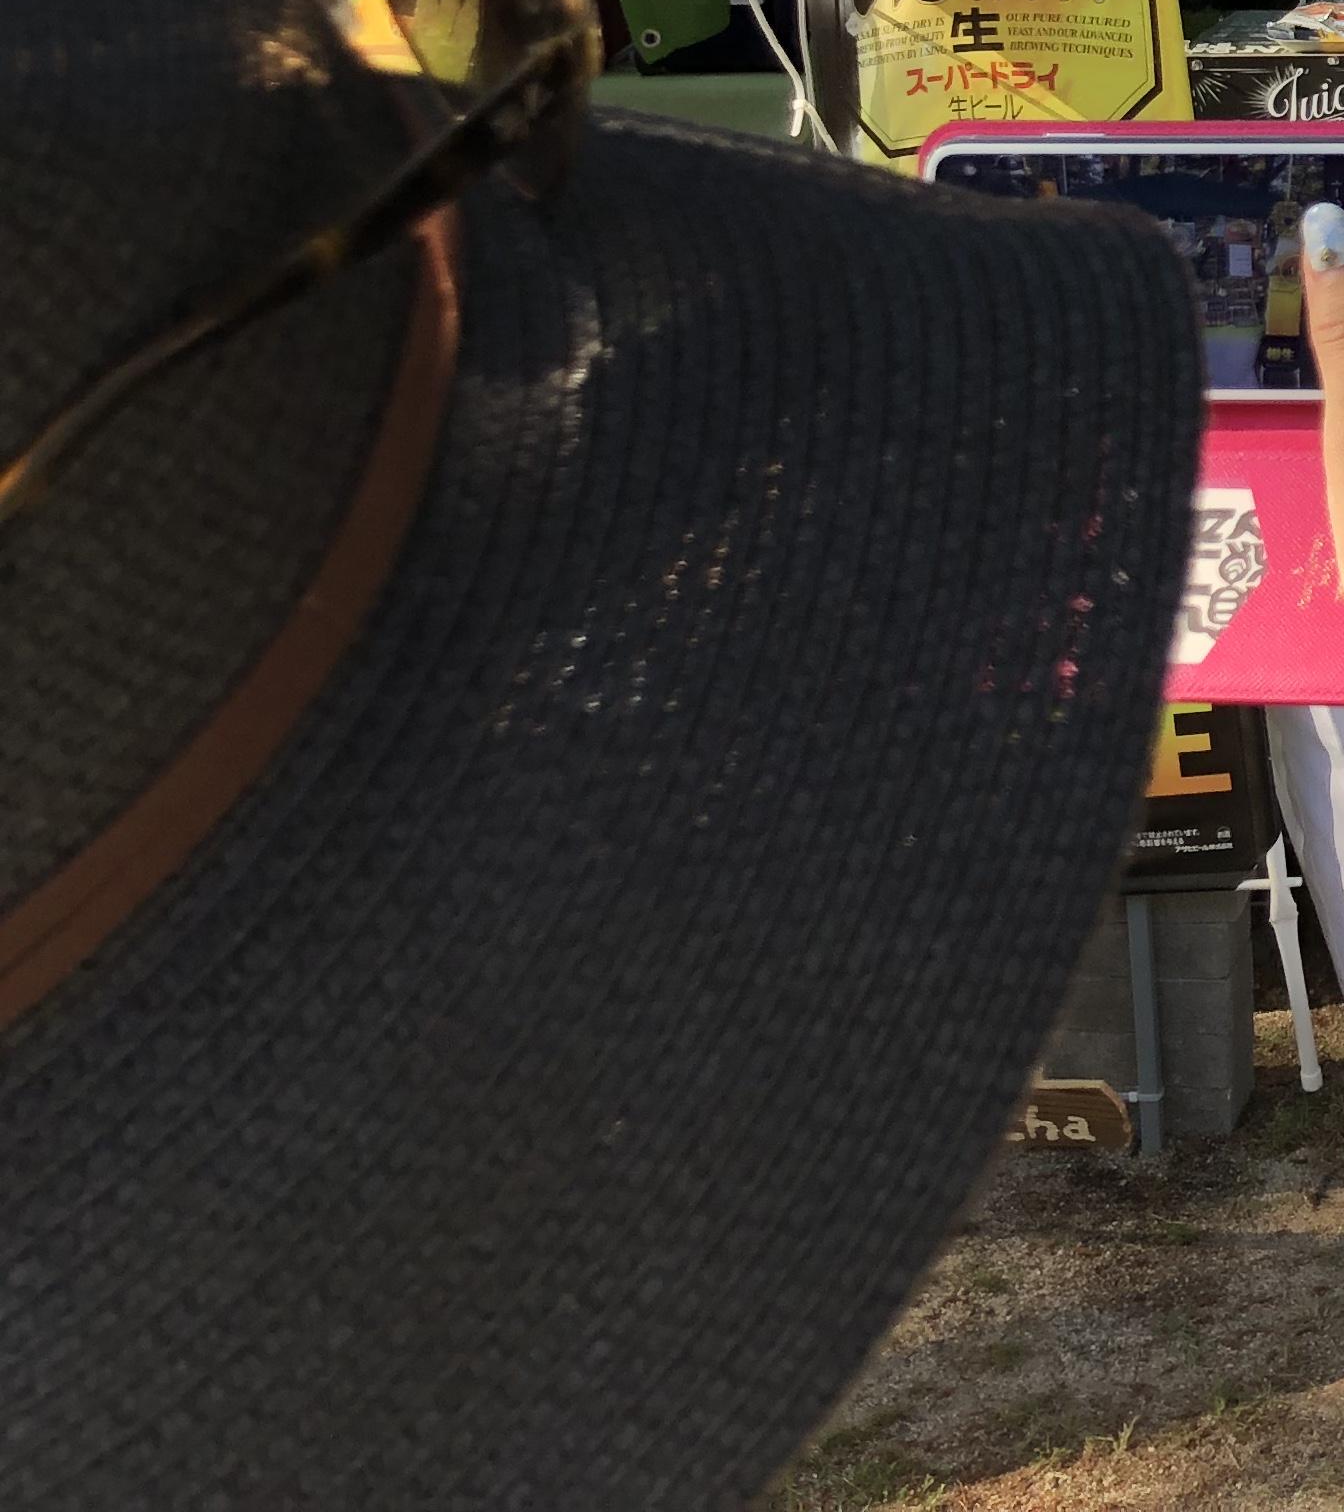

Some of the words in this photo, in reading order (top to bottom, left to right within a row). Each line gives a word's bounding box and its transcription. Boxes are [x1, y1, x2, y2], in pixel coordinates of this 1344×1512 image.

[951, 7, 1005, 54] 生
[1005, 13, 1030, 22] OUR
[1066, 14, 1131, 28] CULTURED
[906, 62, 1059, 96] スーパードライ
[949, 95, 1024, 121] 生ビール
